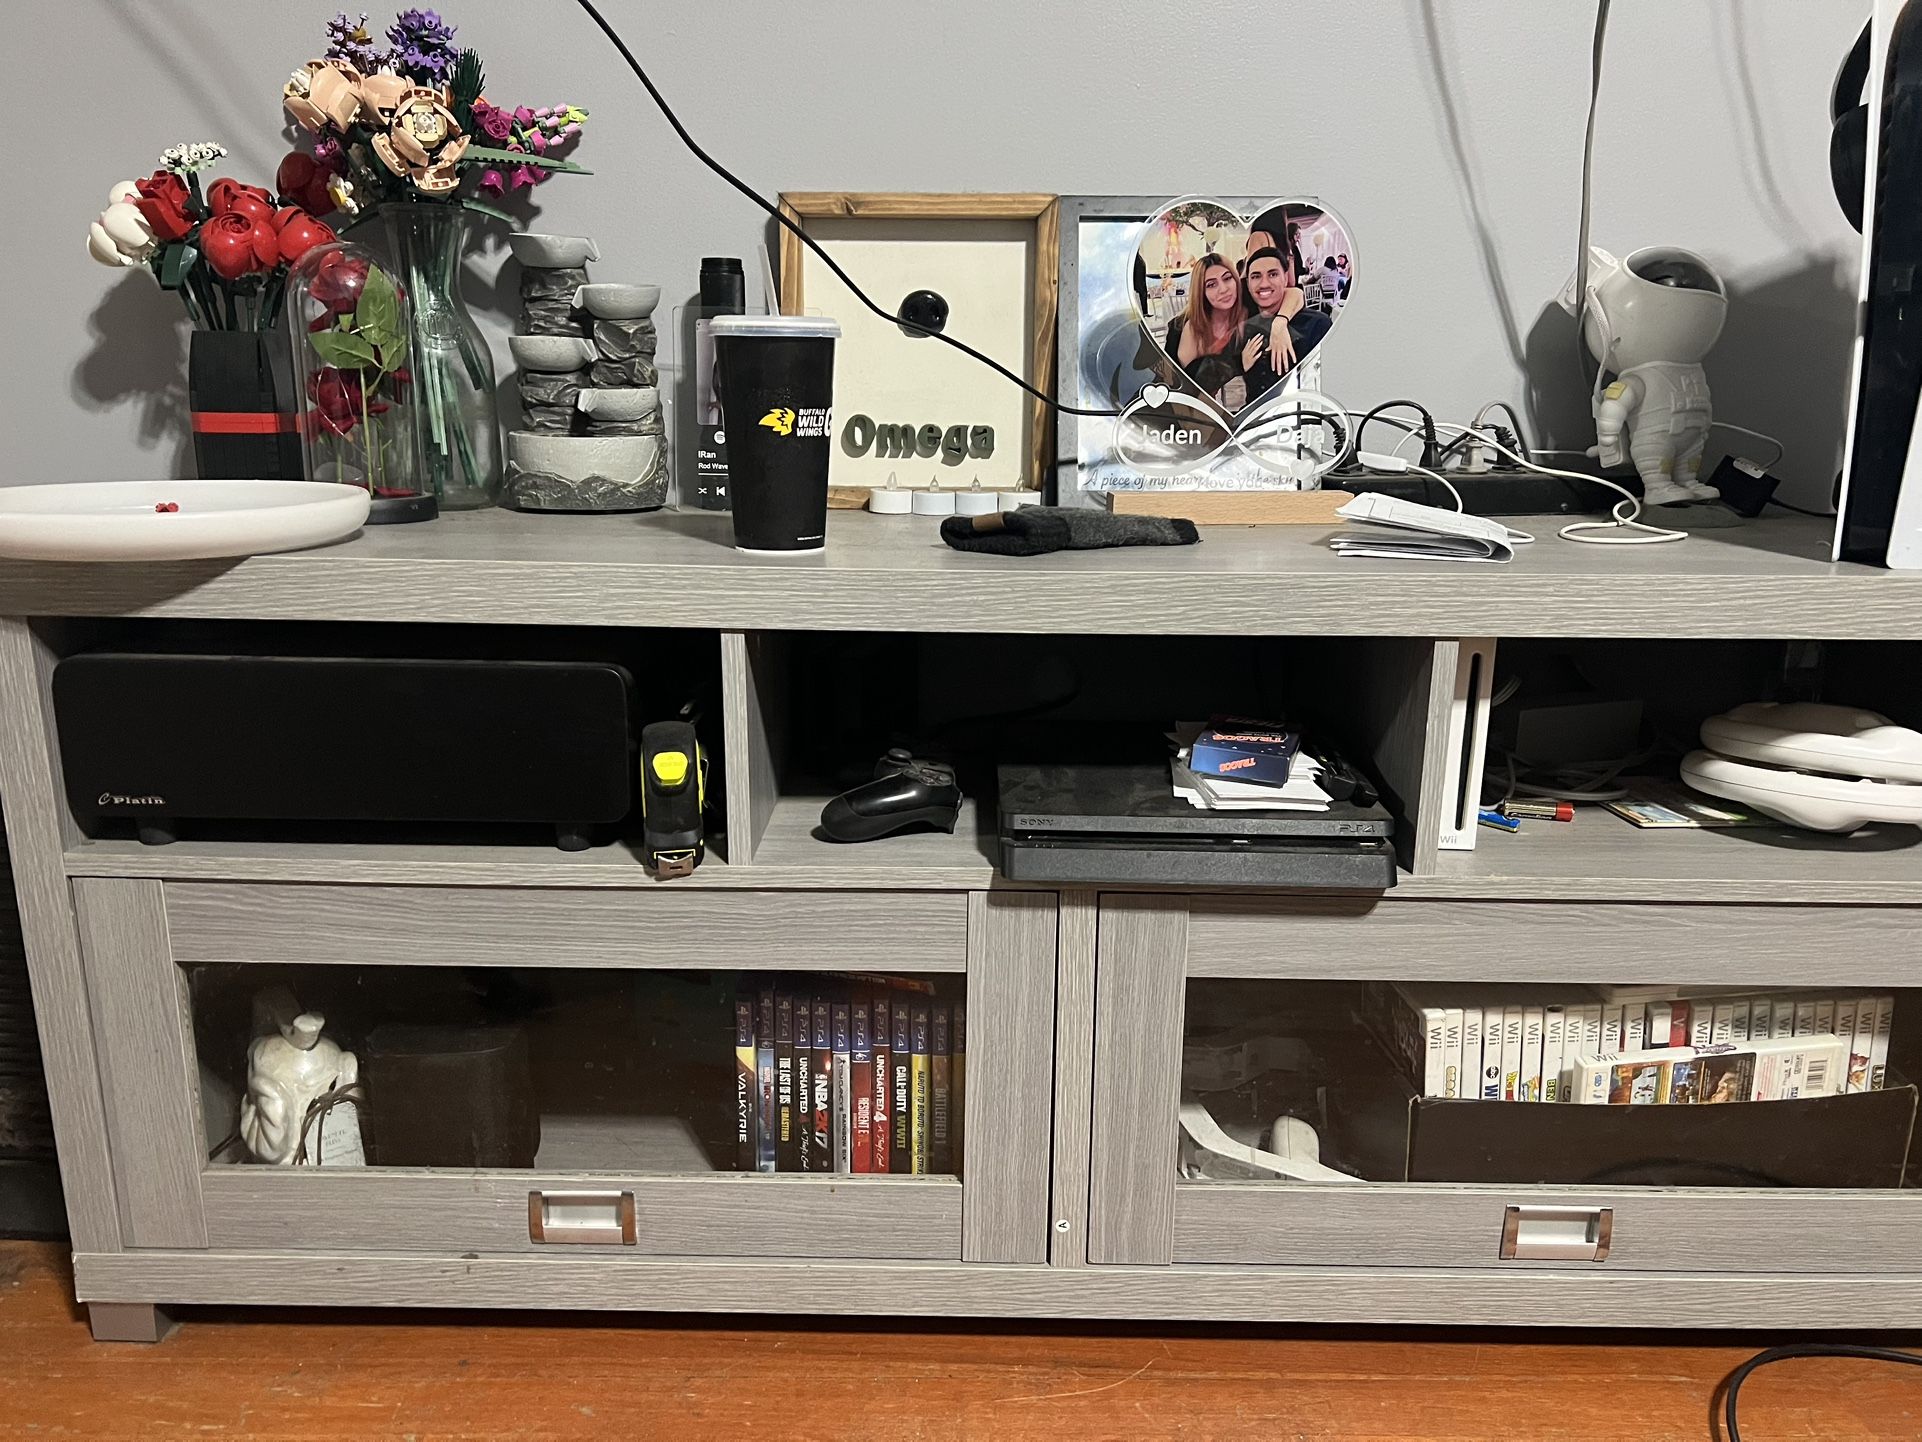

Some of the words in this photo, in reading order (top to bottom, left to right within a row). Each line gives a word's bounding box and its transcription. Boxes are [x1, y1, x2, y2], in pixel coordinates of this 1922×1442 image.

[798, 415, 825, 428] WILD
[799, 408, 826, 416] BUFFALO
[796, 427, 823, 437] WINGS
[841, 414, 995, 467] Omega
[1140, 424, 1202, 445] Jaden
[1101, 473, 1130, 490] piece
[1149, 473, 1169, 490] my
[112, 796, 166, 805] Platin
[1020, 817, 1054, 827] SONY
[1338, 823, 1376, 834] PS4
[1440, 836, 1457, 845] Wii
[1466, 1023, 1479, 1046] Wii
[1488, 1023, 1500, 1046] Wii
[1506, 1021, 1519, 1044] Wii
[1527, 1022, 1540, 1045] Wii
[1548, 1021, 1562, 1044] Wii
[1566, 1020, 1580, 1043] Wii
[1586, 1020, 1598, 1043] Wii
[1605, 1019, 1618, 1042] Wii
[1629, 1017, 1643, 1039] Wii
[1695, 1021, 1709, 1044] Wii
[1715, 1018, 1729, 1041] Wii
[1733, 1016, 1747, 1038] Wii
[1754, 1015, 1767, 1037] Wii
[1839, 1014, 1852, 1037] Wii
[1858, 1012, 1872, 1035] Wii
[1878, 1012, 1891, 1034] Wii
[837, 1023, 845, 1048] PS4
[857, 1022, 865, 1048] PS4
[897, 1023, 905, 1048] PS4
[917, 1026, 925, 1052] PS4
[1428, 1026, 1442, 1049] Wii
[1446, 1026, 1459, 1048] Wii
[1592, 1053, 1618, 1063] Wii
[779, 1069, 791, 1086] LAST
[799, 1057, 808, 1114] UNCHARTED
[876, 1054, 885, 1111] UNCHARTED
[896, 1065, 907, 1087] CALL
[917, 1070, 925, 1094] NARUTO
[896, 1088, 907, 1112] DUTY
[917, 1095, 925, 1103] TO
[1545, 1078, 1557, 1101] BEN
[738, 1072, 747, 1143] VALKYRIE
[857, 1097, 870, 1129] RESIDENT
[873, 1110, 888, 1123] 4
[934, 1088, 947, 1138] BATTLEFIELD
[896, 1115, 906, 1149] WWII
